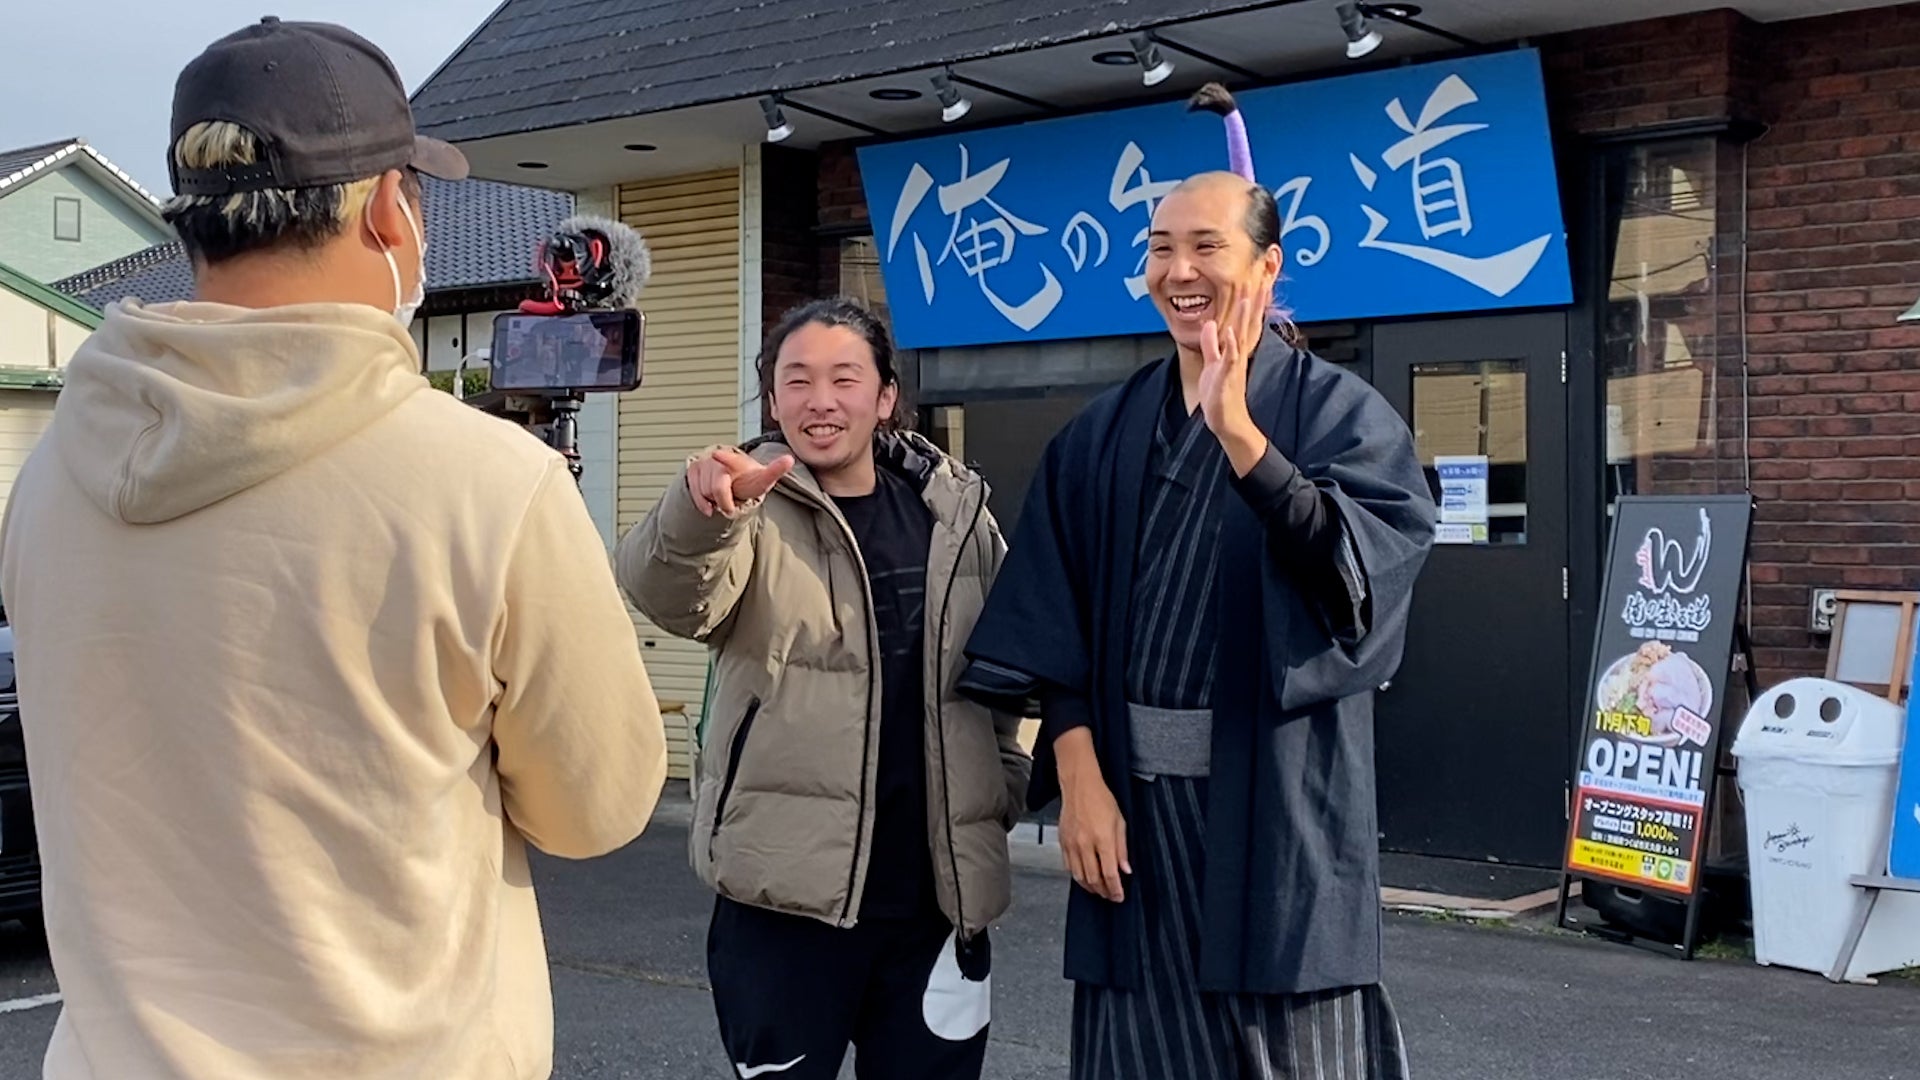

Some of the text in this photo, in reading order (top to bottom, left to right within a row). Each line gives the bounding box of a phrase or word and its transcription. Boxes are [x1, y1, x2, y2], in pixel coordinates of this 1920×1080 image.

[1595, 711, 1651, 737] 11月下旬
[1587, 738, 1703, 790] OPEN!
